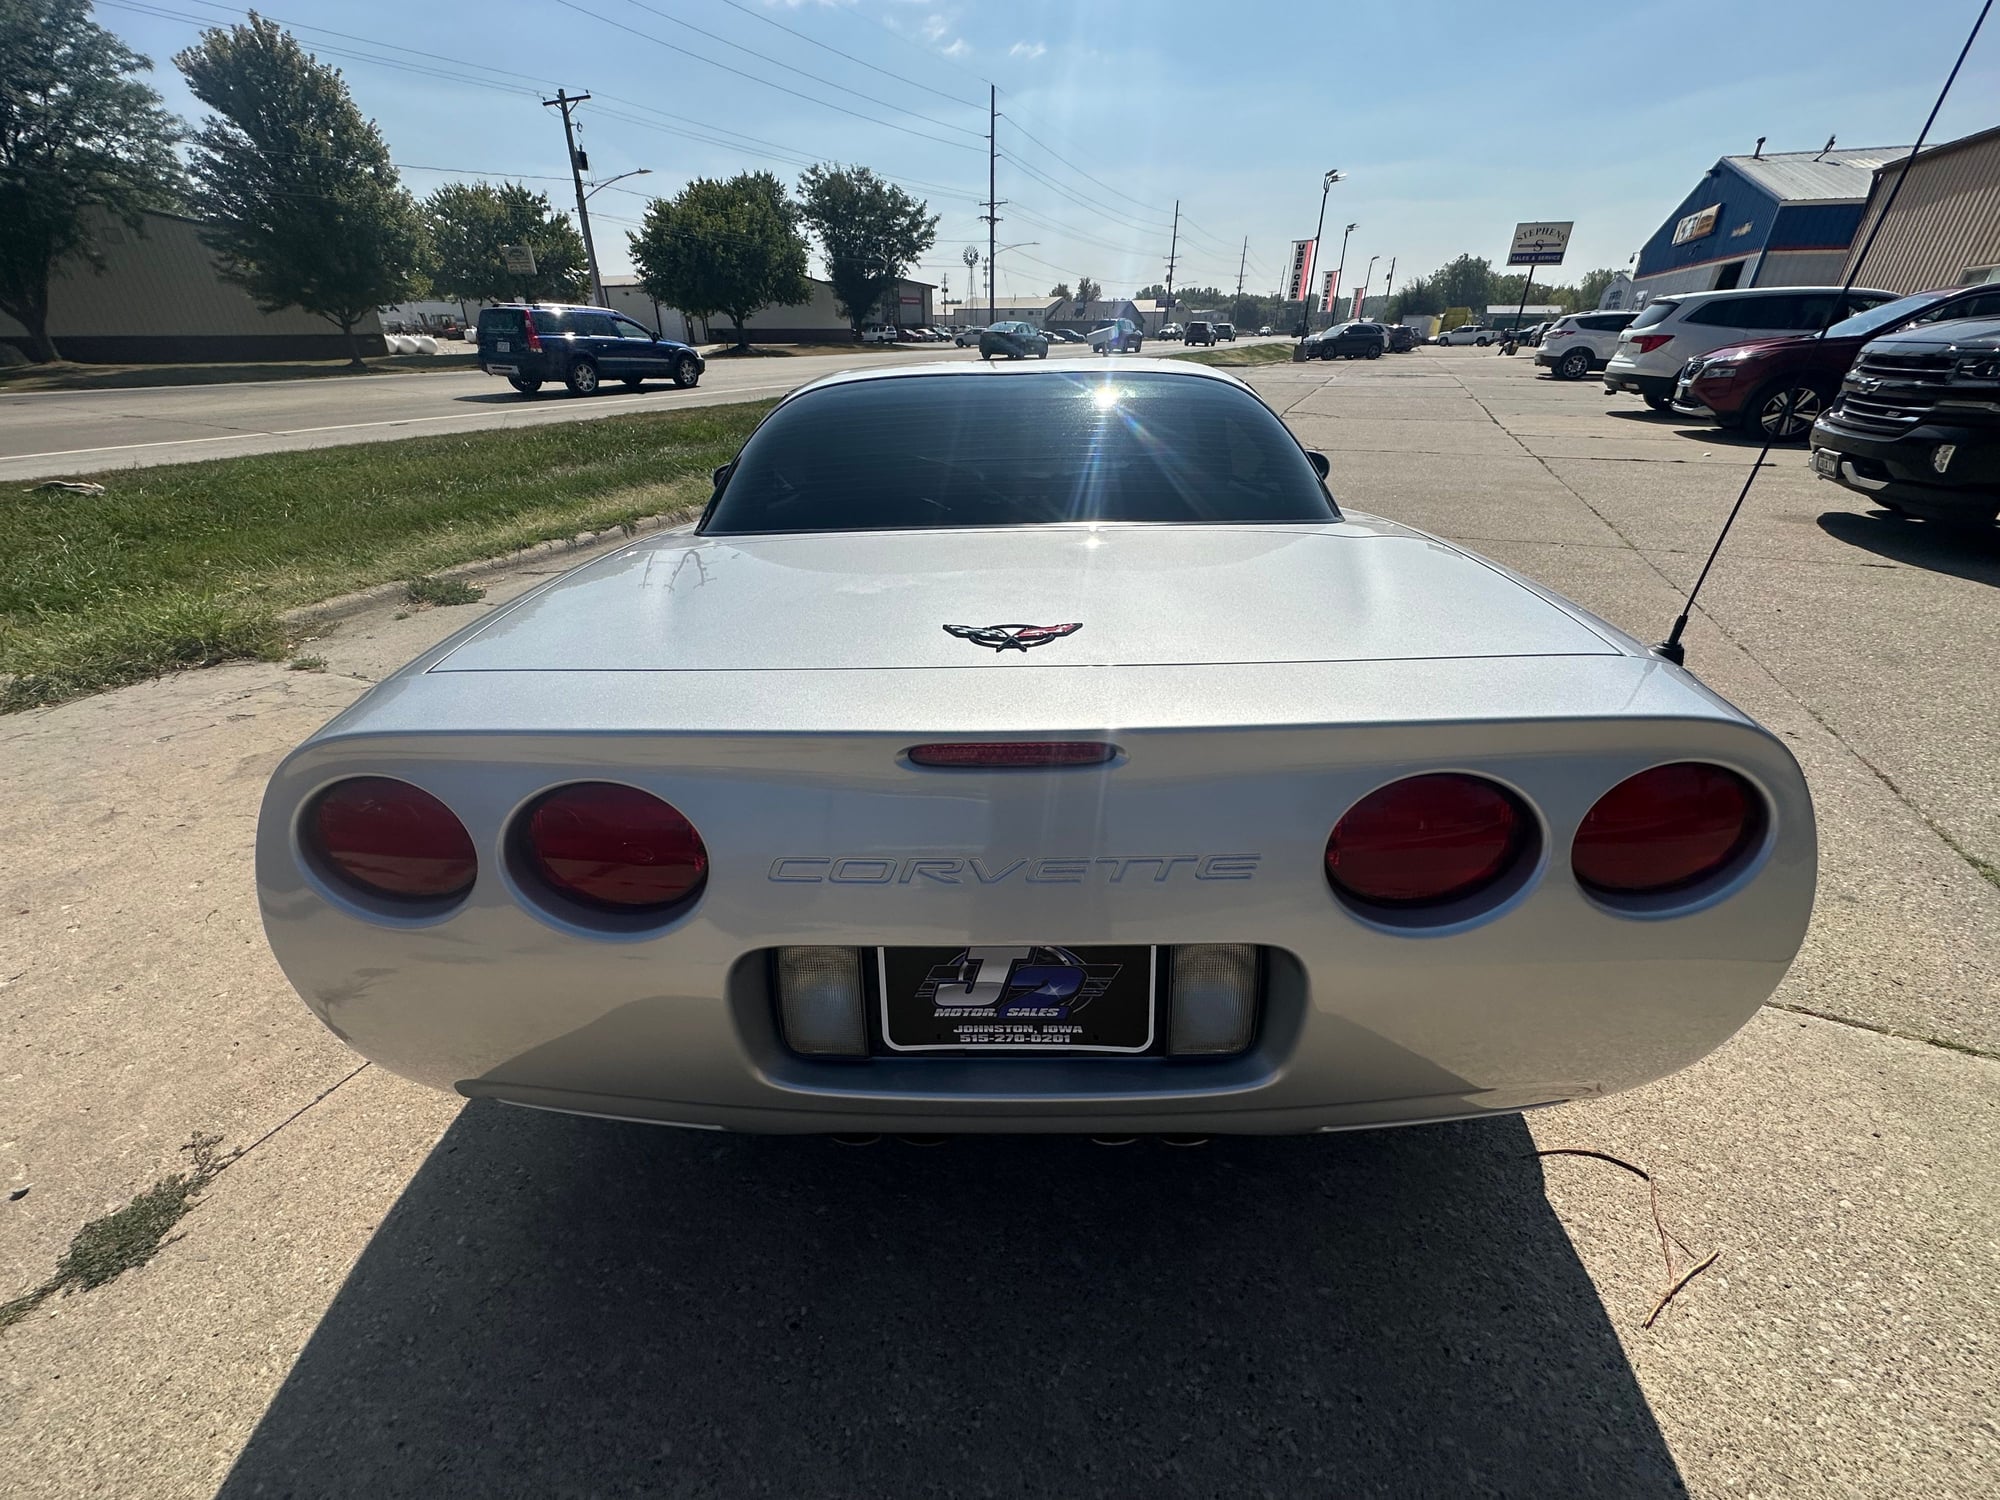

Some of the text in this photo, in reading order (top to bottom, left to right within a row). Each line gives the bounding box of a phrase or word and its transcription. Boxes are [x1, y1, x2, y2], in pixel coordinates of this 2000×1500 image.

[1516, 227, 1567, 242] STEPHENS
[1533, 239, 1545, 252] S
[1290, 244, 1305, 299] USED CARS
[767, 852, 1262, 885] CORVETTE
[1006, 1008, 1060, 1017] SALES
[953, 1025, 1083, 1034] JOHNSTON, IOWA
[960, 1034, 1071, 1043] 515-270-0201
